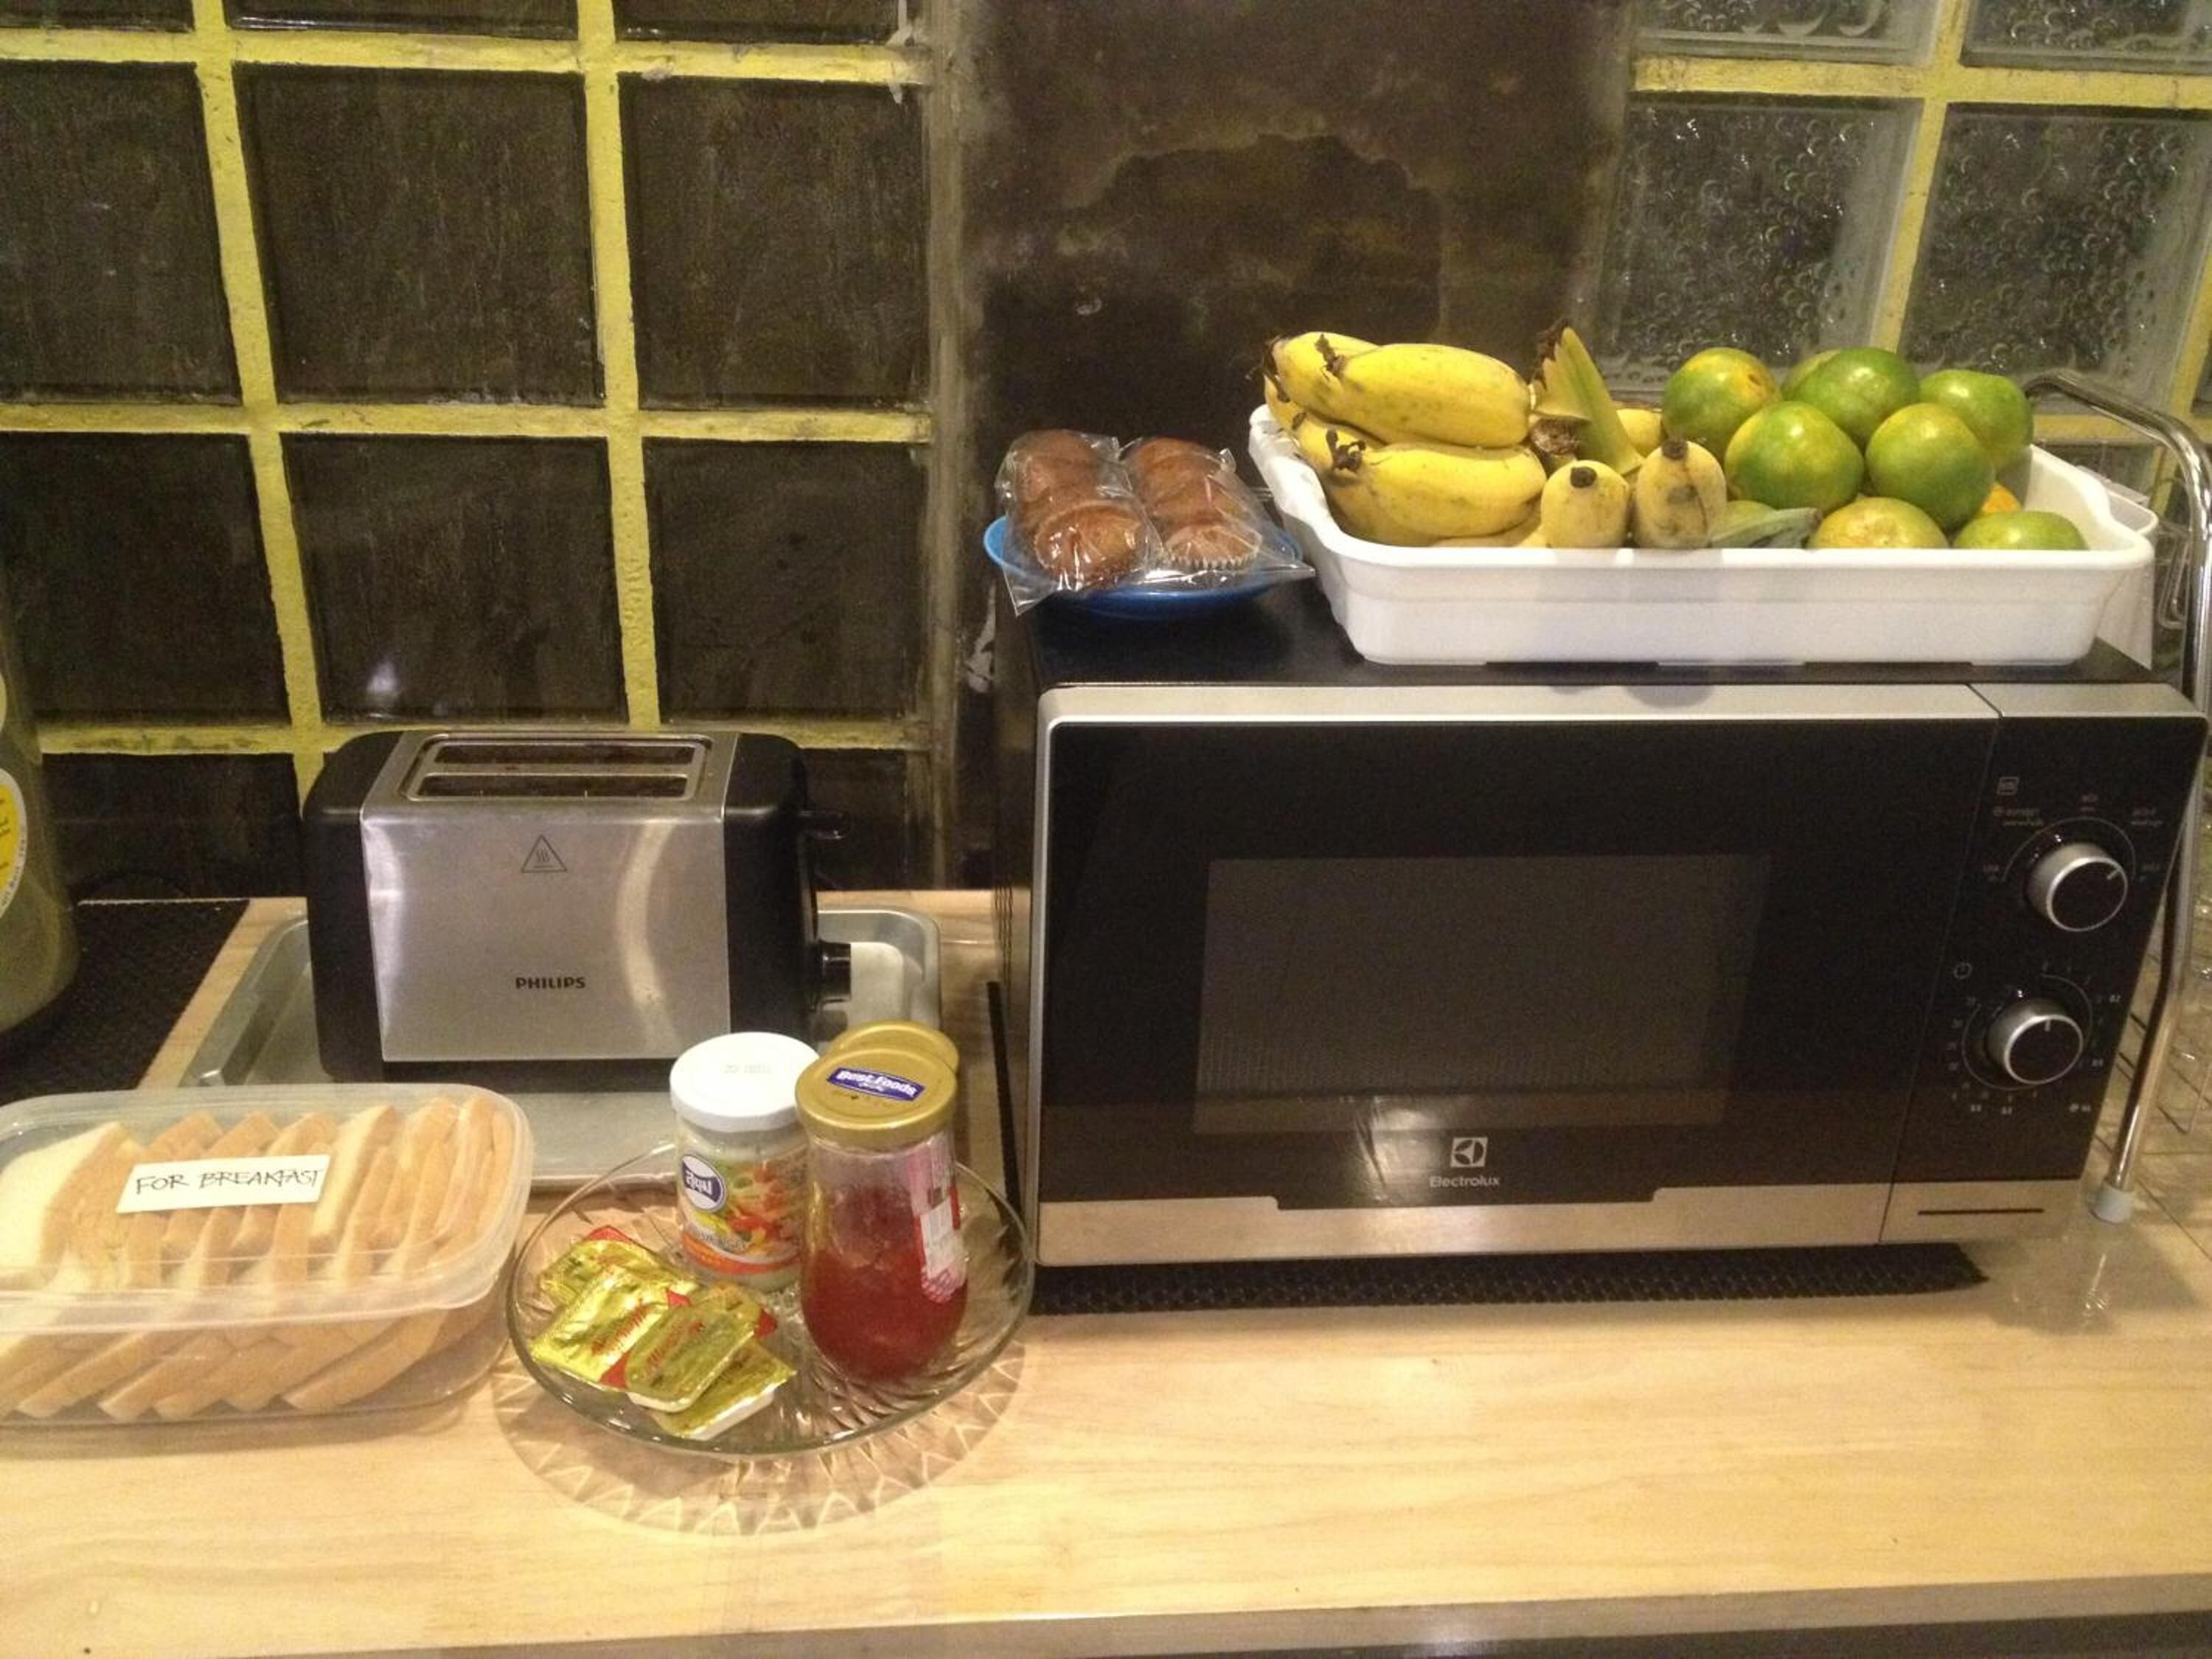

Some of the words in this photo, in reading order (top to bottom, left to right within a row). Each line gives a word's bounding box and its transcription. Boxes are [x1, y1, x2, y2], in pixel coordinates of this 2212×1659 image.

[515, 976, 586, 990] PHILIPS
[135, 1173, 189, 1195] FOR
[198, 1168, 321, 1189] BREAKFAST
[1429, 1175, 1500, 1189] Electrolux
